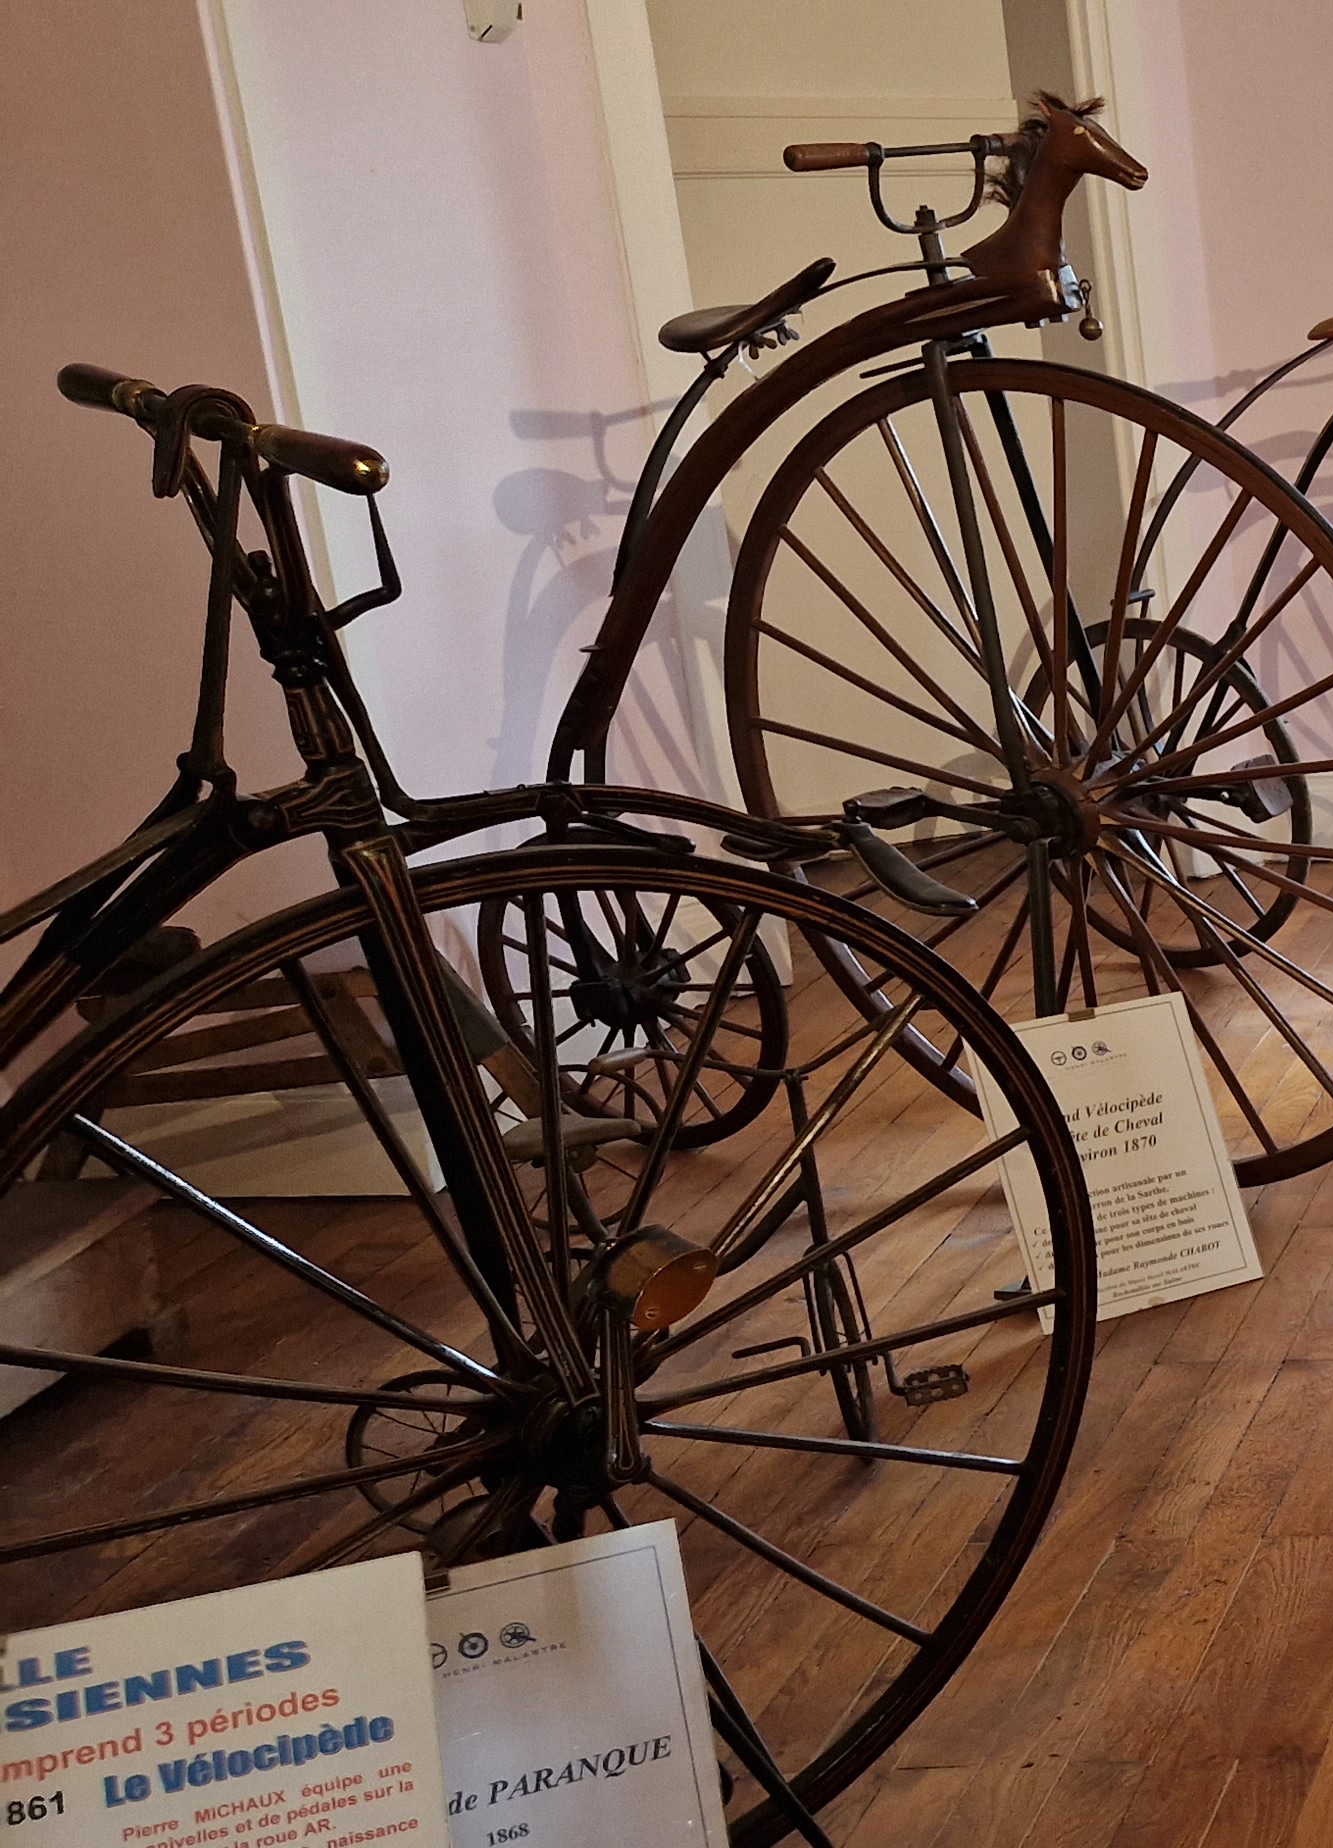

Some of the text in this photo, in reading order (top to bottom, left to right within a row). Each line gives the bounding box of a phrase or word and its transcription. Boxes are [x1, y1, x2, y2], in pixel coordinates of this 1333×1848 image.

[1085, 1092, 1162, 1118] Vélocipède
[1094, 1125, 1109, 1138] de
[1114, 1112, 1163, 1133] Cheval
[1081, 1134, 1157, 1162] viron 1870
[1112, 1176, 1155, 1192] artisanale
[1157, 1172, 1173, 1184] par
[1096, 1213, 1108, 1221] de
[1109, 1207, 1130, 1218] trois
[1131, 1202, 1155, 1215] types
[1157, 1198, 1168, 1207] de
[1169, 1190, 1210, 1204] machines
[1114, 1196, 1125, 1204] de
[1126, 1193, 1136, 1201] la
[1109, 1221, 1129, 1233] pour
[1159, 1210, 1169, 1219] de
[1170, 1203, 1197, 1216] cheval
[1133, 1252, 1178, 1270] Raymonde
[1180, 1241, 1220, 1257] CHABOT
[5, 1640, 310, 1732] SIENNES
[1, 1688, 341, 1782] mprend 3 périodes
[103, 1715, 395, 1808] Le Vélocipède
[448, 1735, 672, 1815] de PARANQUE
[7, 1791, 65, 1825] 861
[122, 1762, 412, 1842] Pierre MICHAUX équipe une
[235, 1819, 254, 1833] et
[258, 1814, 281, 1828] de
[287, 1795, 358, 1824] pédales
[363, 1785, 393, 1802] sur
[398, 1780, 414, 1793] la
[257, 1830, 297, 1848] roue
[327, 1818, 418, 1848] naissance
[486, 1822, 530, 1847] 1868
